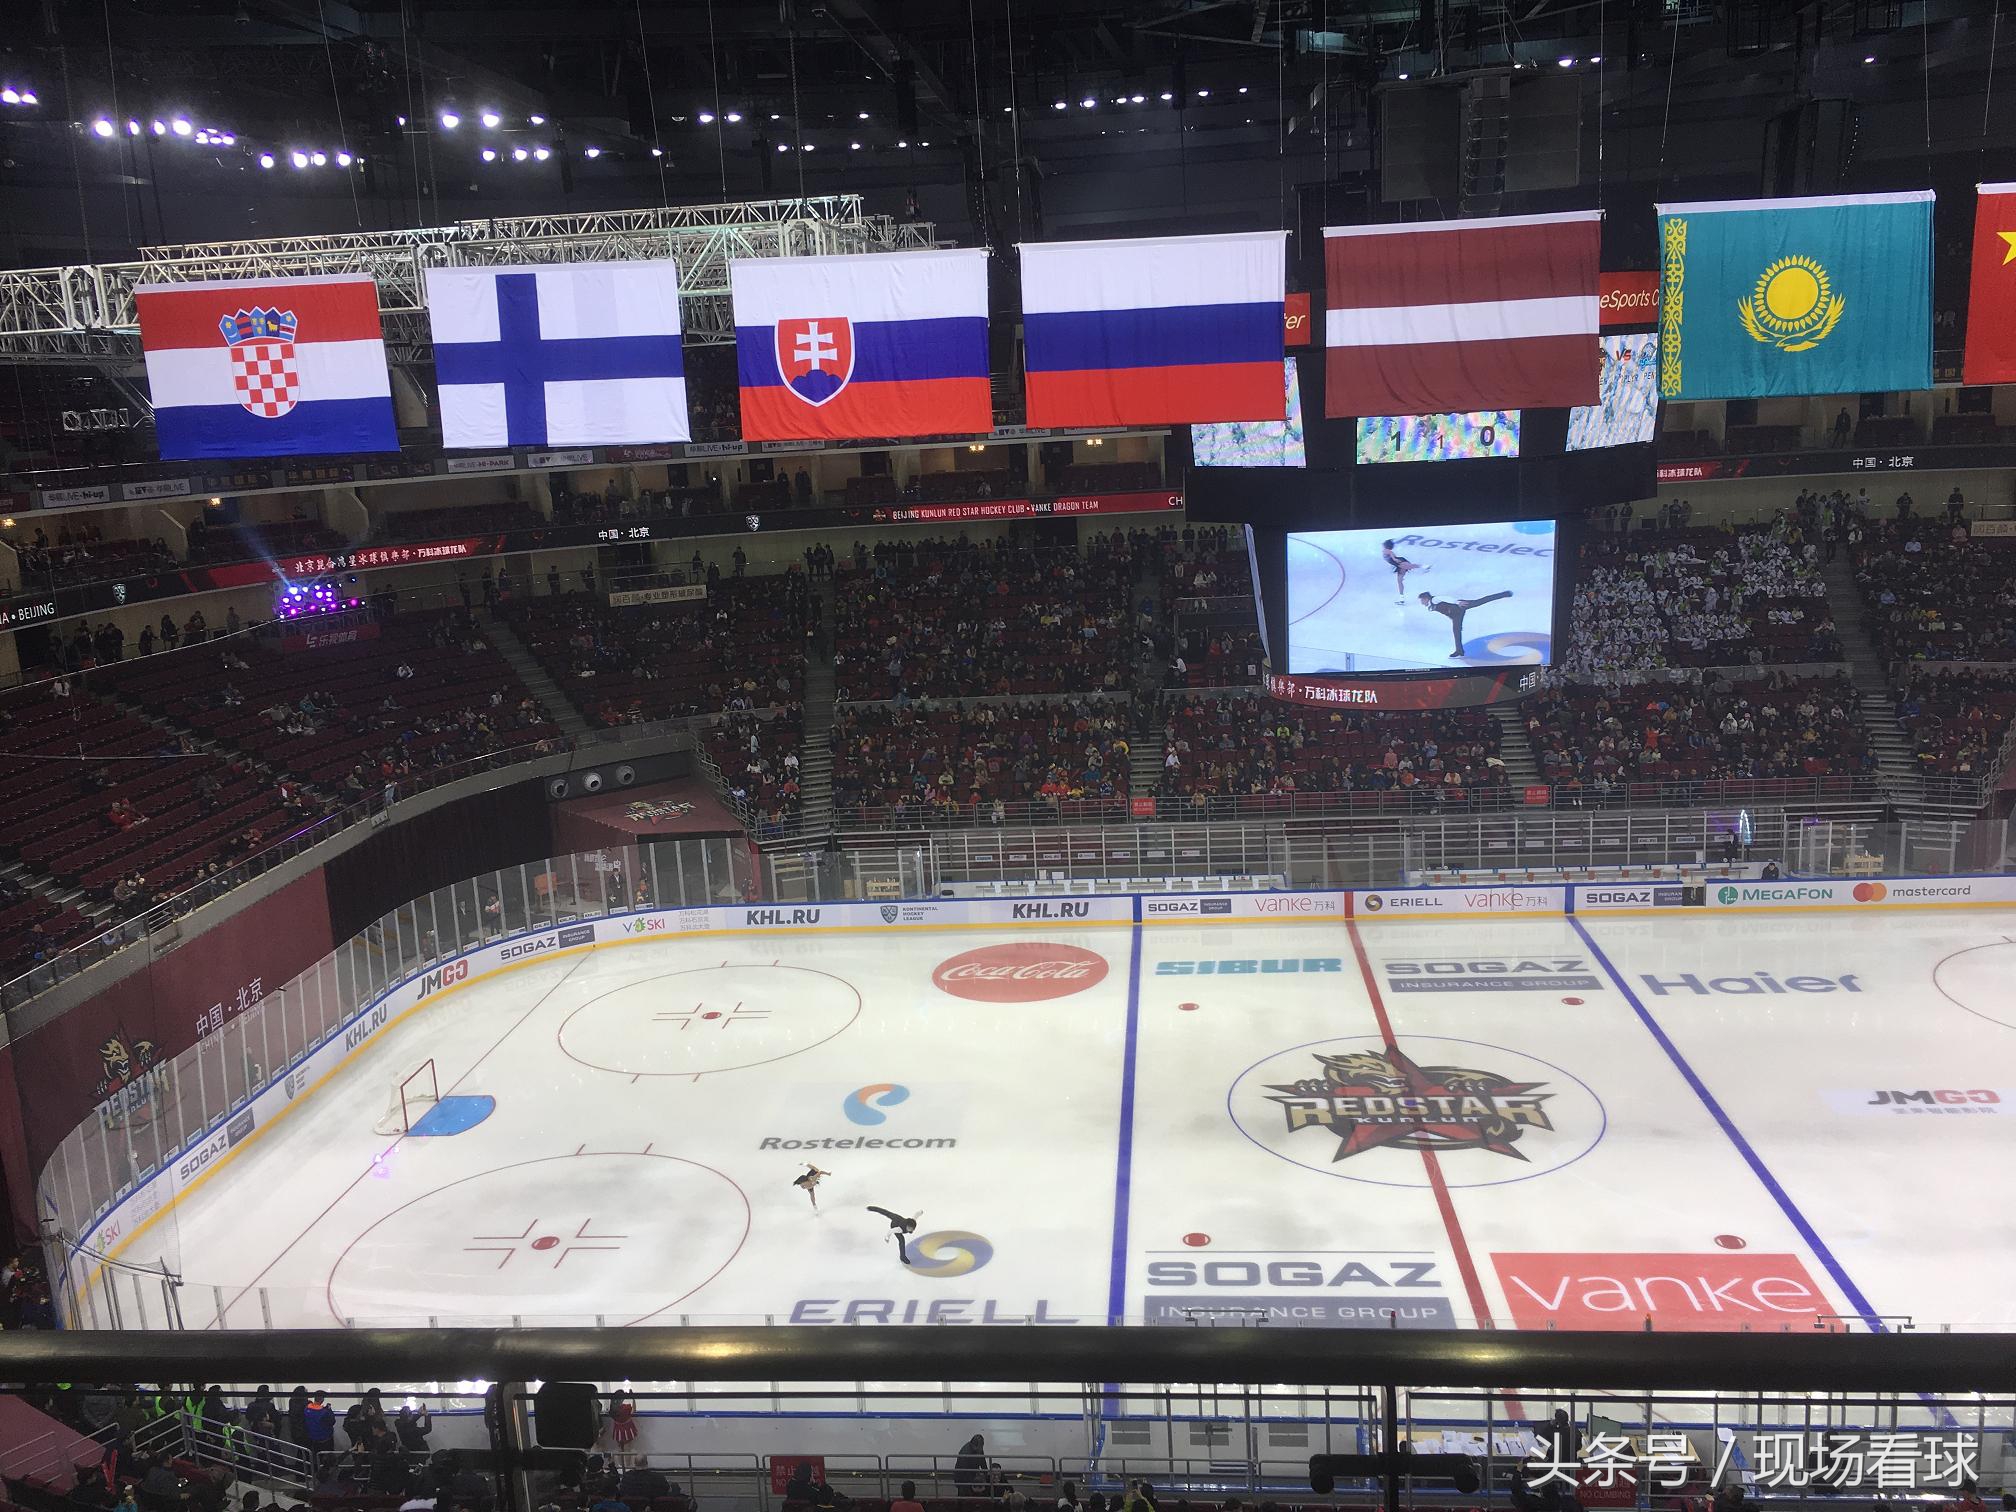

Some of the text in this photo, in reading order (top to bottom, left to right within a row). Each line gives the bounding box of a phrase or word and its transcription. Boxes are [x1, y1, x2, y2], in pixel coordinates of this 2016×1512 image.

[1600, 289, 1650, 311] eSports
[1615, 349, 1632, 361] VS
[1390, 426, 1495, 451] 1 1 0
[892, 500, 1099, 520] BEIJING KUNLUN RED STAR HOCKEY CLUB VANKE DRAGON TEAM
[598, 526, 650, 541] 中国·北京
[18, 602, 55, 621] BEIJING
[1464, 889, 1548, 909] vanke 万科
[1586, 891, 1651, 904] SOGAZ
[1892, 885, 1972, 898] mastercard
[1012, 901, 1089, 919] KHL.RU
[1148, 902, 1198, 912] SOGAZ
[1255, 896, 1336, 912] vanke 万科
[1390, 896, 1443, 907] ERIELL
[746, 908, 821, 925] KHL.RU
[500, 936, 556, 960] SOGAZ
[1155, 957, 1342, 976] SIBUR
[1384, 959, 1589, 975] SOGAZ
[1399, 978, 1590, 990] INSURANCE GROUP
[1639, 971, 1864, 996] Haier
[196, 977, 263, 1038] 中国·北京
[345, 1003, 388, 1052] KHL.RU
[759, 1135, 957, 1152] Rostelecom
[180, 1134, 226, 1181] SOGAZ
[1146, 1261, 1443, 1289] SOGAZ
[1510, 1272, 1817, 1313] vanke
[788, 1298, 1080, 1325] ERIELL
[1337, 1306, 1438, 1319] GROUP
